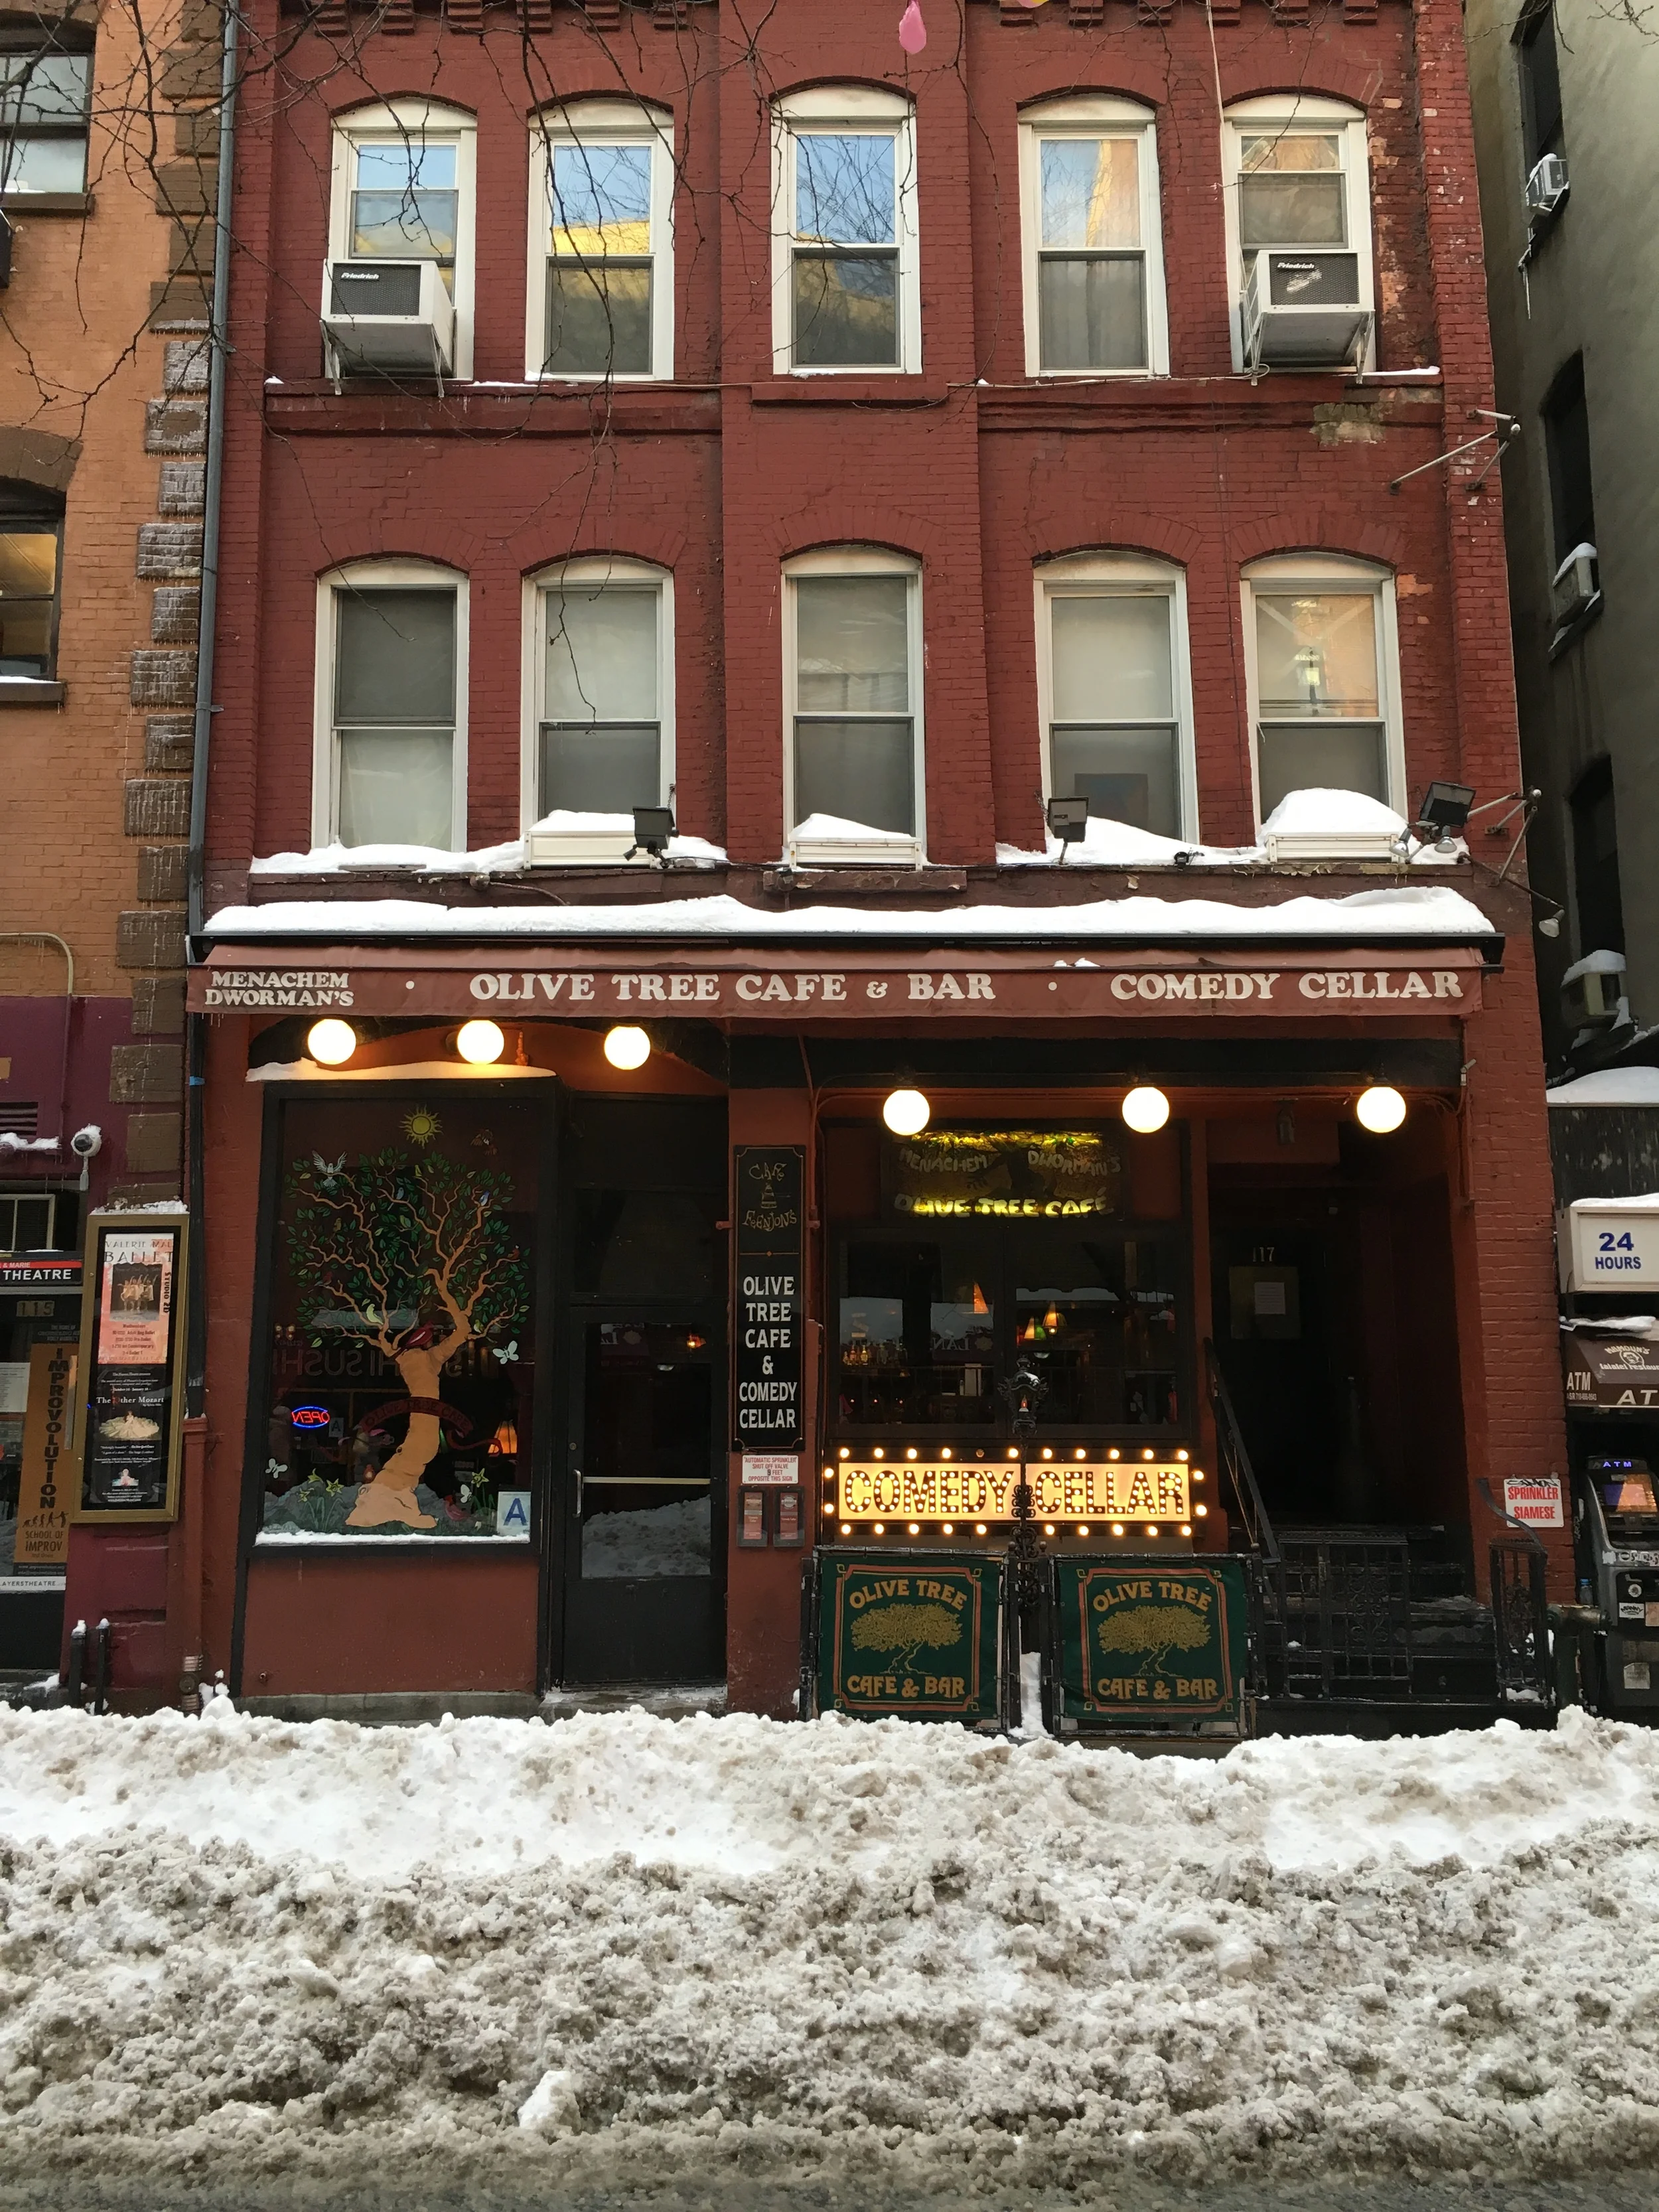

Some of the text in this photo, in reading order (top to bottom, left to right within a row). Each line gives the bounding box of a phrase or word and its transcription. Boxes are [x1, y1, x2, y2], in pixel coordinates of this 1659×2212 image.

[211, 972, 349, 988] MENACHEM
[469, 973, 996, 1001] OLIVE TREE CAFE & BAR
[1111, 971, 1464, 999] COMEDY CELLAR
[205, 988, 354, 1006] DWORMAN'S
[899, 1147, 988, 1173] MENACHEM
[894, 1193, 971, 1218] OLIVE
[975, 1197, 1040, 1218] TREE
[1599, 1232, 1634, 1251] 24
[1253, 1247, 1275, 1262] 117
[1595, 1256, 1641, 1270] HOURS
[3, 1269, 72, 1280] THEATRE
[743, 1276, 795, 1295] OLIVE
[22, 1302, 53, 1315] 115
[746, 1303, 792, 1321] TREE
[745, 1329, 792, 1348] CAFE
[762, 1355, 774, 1374] &
[1566, 1372, 1591, 1391] ATM
[739, 1382, 798, 1402] COMEDY
[1617, 1390, 1658, 1406] AT
[739, 1408, 796, 1428] CELLAR
[40, 1348, 70, 1509] IMPROVOLUTION
[845, 1470, 1184, 1514] COMEDY CELLAR
[1508, 1487, 1559, 1500] SPRINKLER
[503, 1498, 528, 1526] A
[1514, 1507, 1555, 1518] SIAMESE
[849, 1579, 967, 1611] OLIVE TREE
[1093, 1581, 1212, 1611] OLIVE TREE
[847, 1675, 965, 1698] CAFE & BAR
[1098, 1678, 1218, 1700] CAFE & BAR
